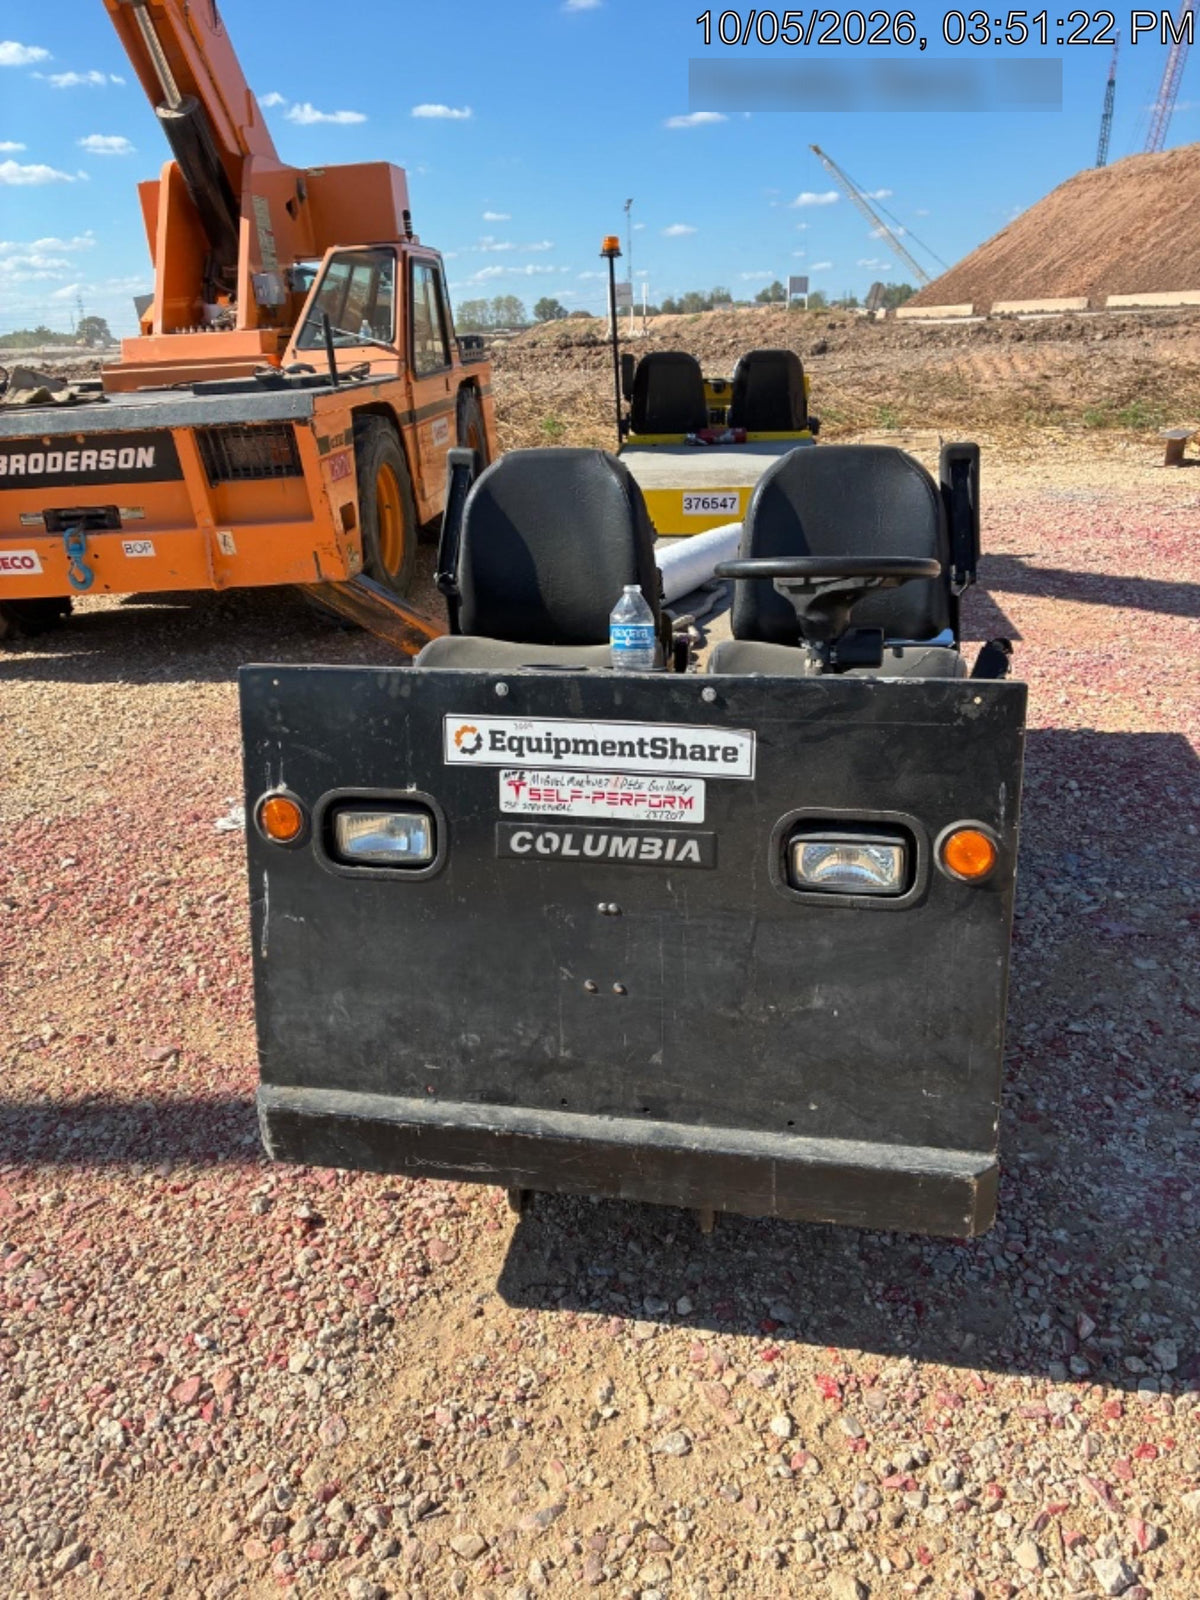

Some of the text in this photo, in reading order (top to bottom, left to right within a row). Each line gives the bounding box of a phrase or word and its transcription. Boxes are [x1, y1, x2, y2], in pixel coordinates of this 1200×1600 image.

[683, 497, 737, 510] 376547
[0, 556, 35, 571] ECO
[488, 729, 739, 764] EquipmentShare
[529, 787, 694, 810] SELF-PERFORM
[509, 831, 702, 863] COLUMBIA
